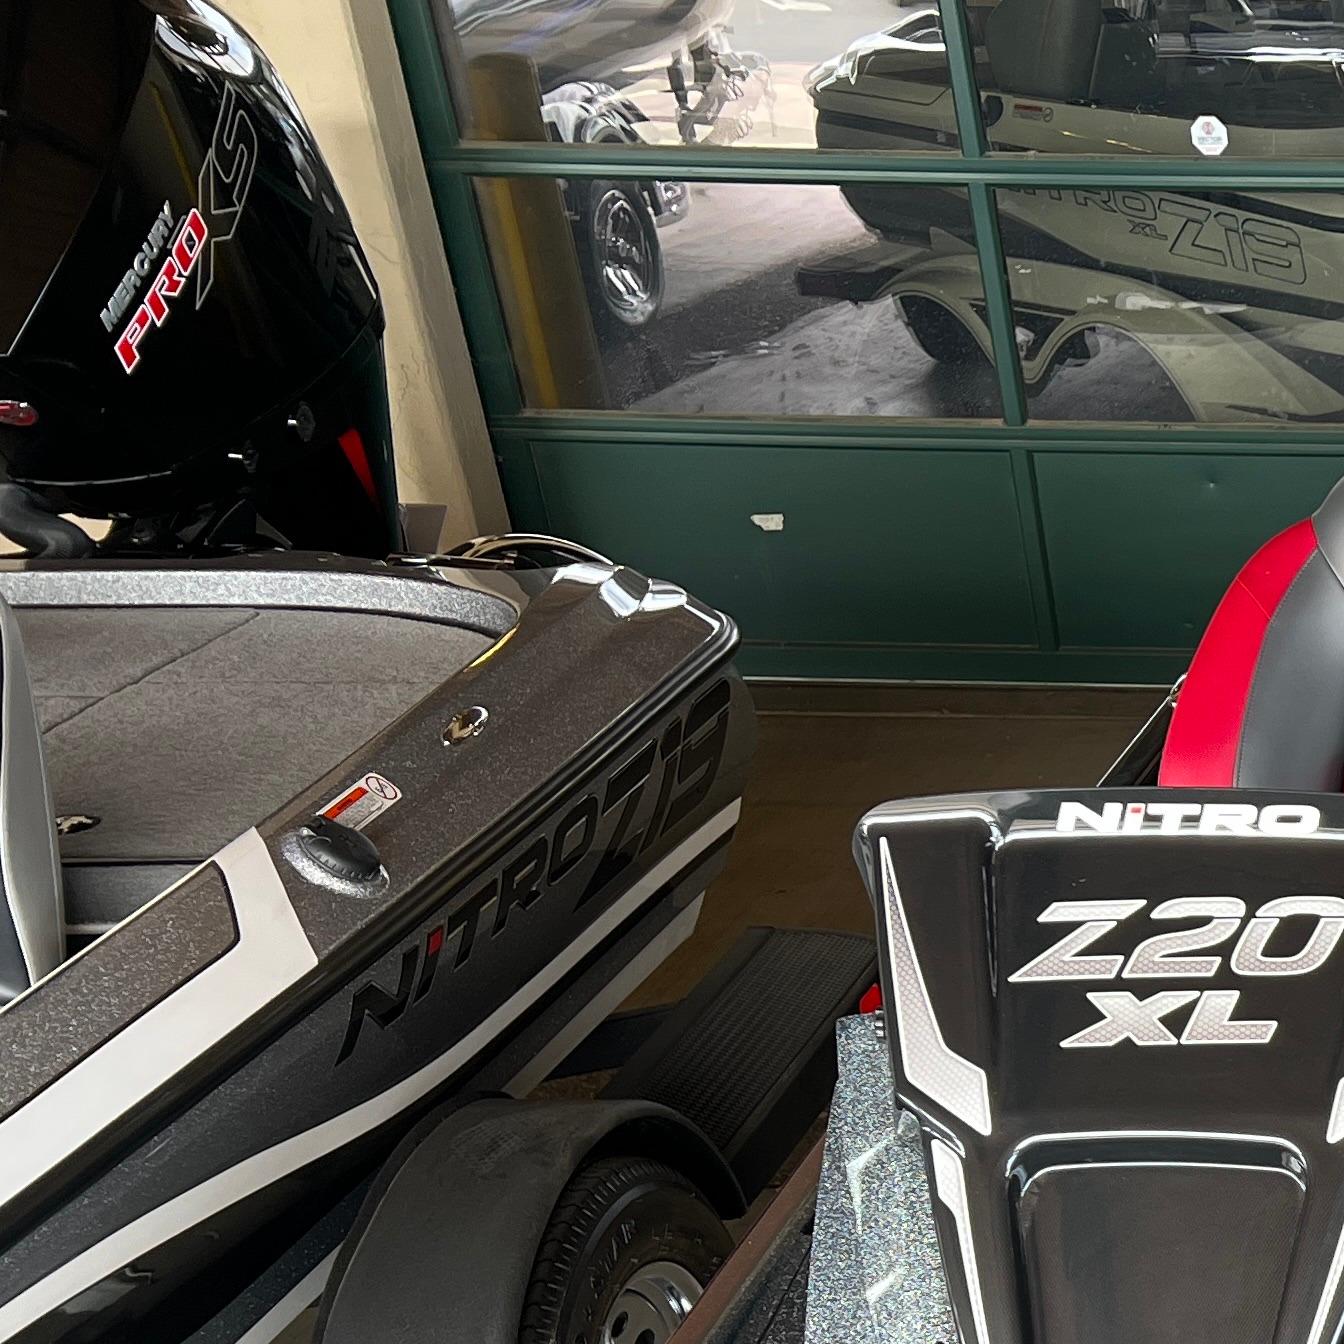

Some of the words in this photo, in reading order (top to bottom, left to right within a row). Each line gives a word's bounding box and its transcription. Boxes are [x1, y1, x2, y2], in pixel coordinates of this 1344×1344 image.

[99, 199, 174, 333] MERCURY
[113, 207, 208, 375] PRO
[1056, 801, 1321, 834] NITRO
[336, 794, 599, 1067] NITRO
[1059, 991, 1278, 1048] XL
